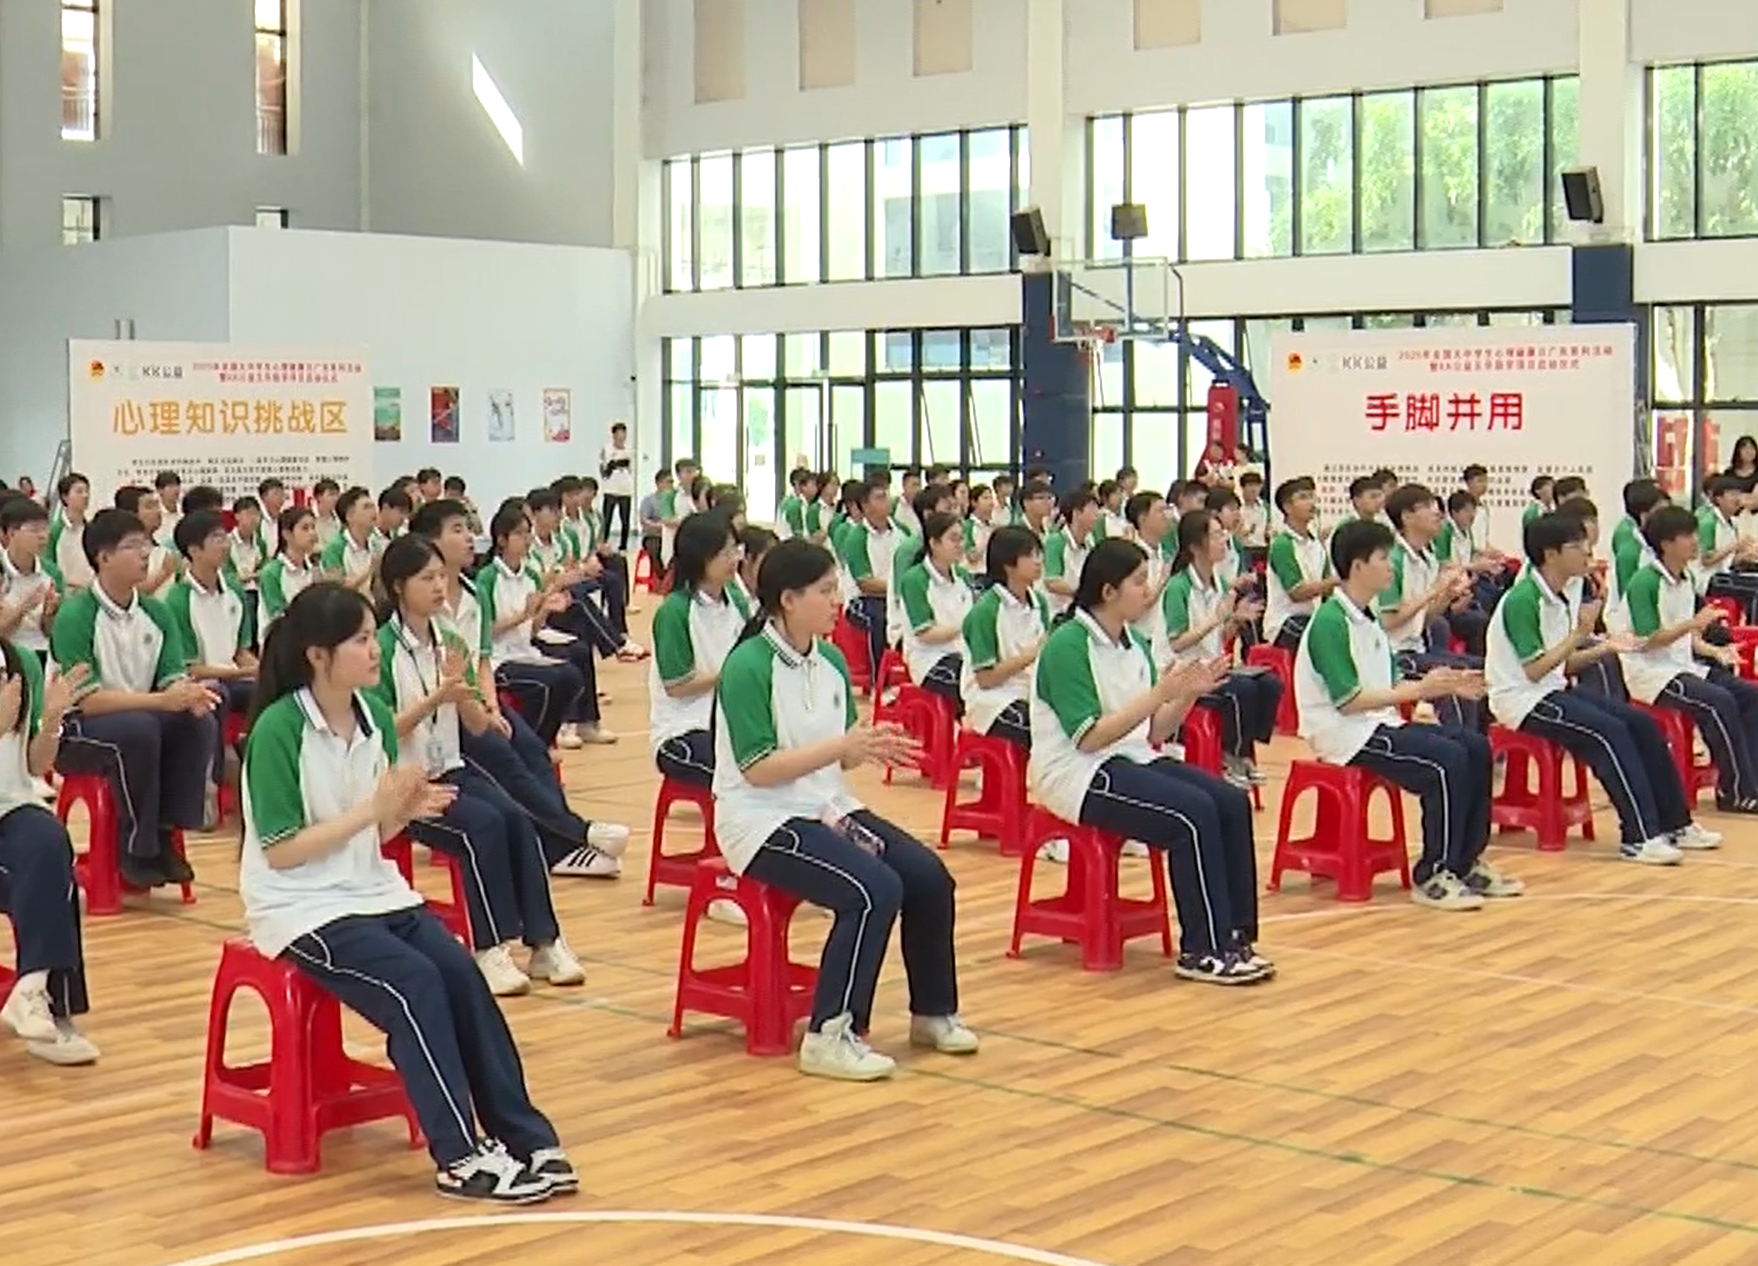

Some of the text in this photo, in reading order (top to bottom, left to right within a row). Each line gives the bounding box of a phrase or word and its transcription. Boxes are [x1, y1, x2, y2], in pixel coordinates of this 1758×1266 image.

[142, 364, 183, 378] KK公益
[1342, 355, 1387, 370] KK公益
[112, 399, 348, 435] 心理知识挑战区
[1364, 392, 1524, 431] 手脚并用
